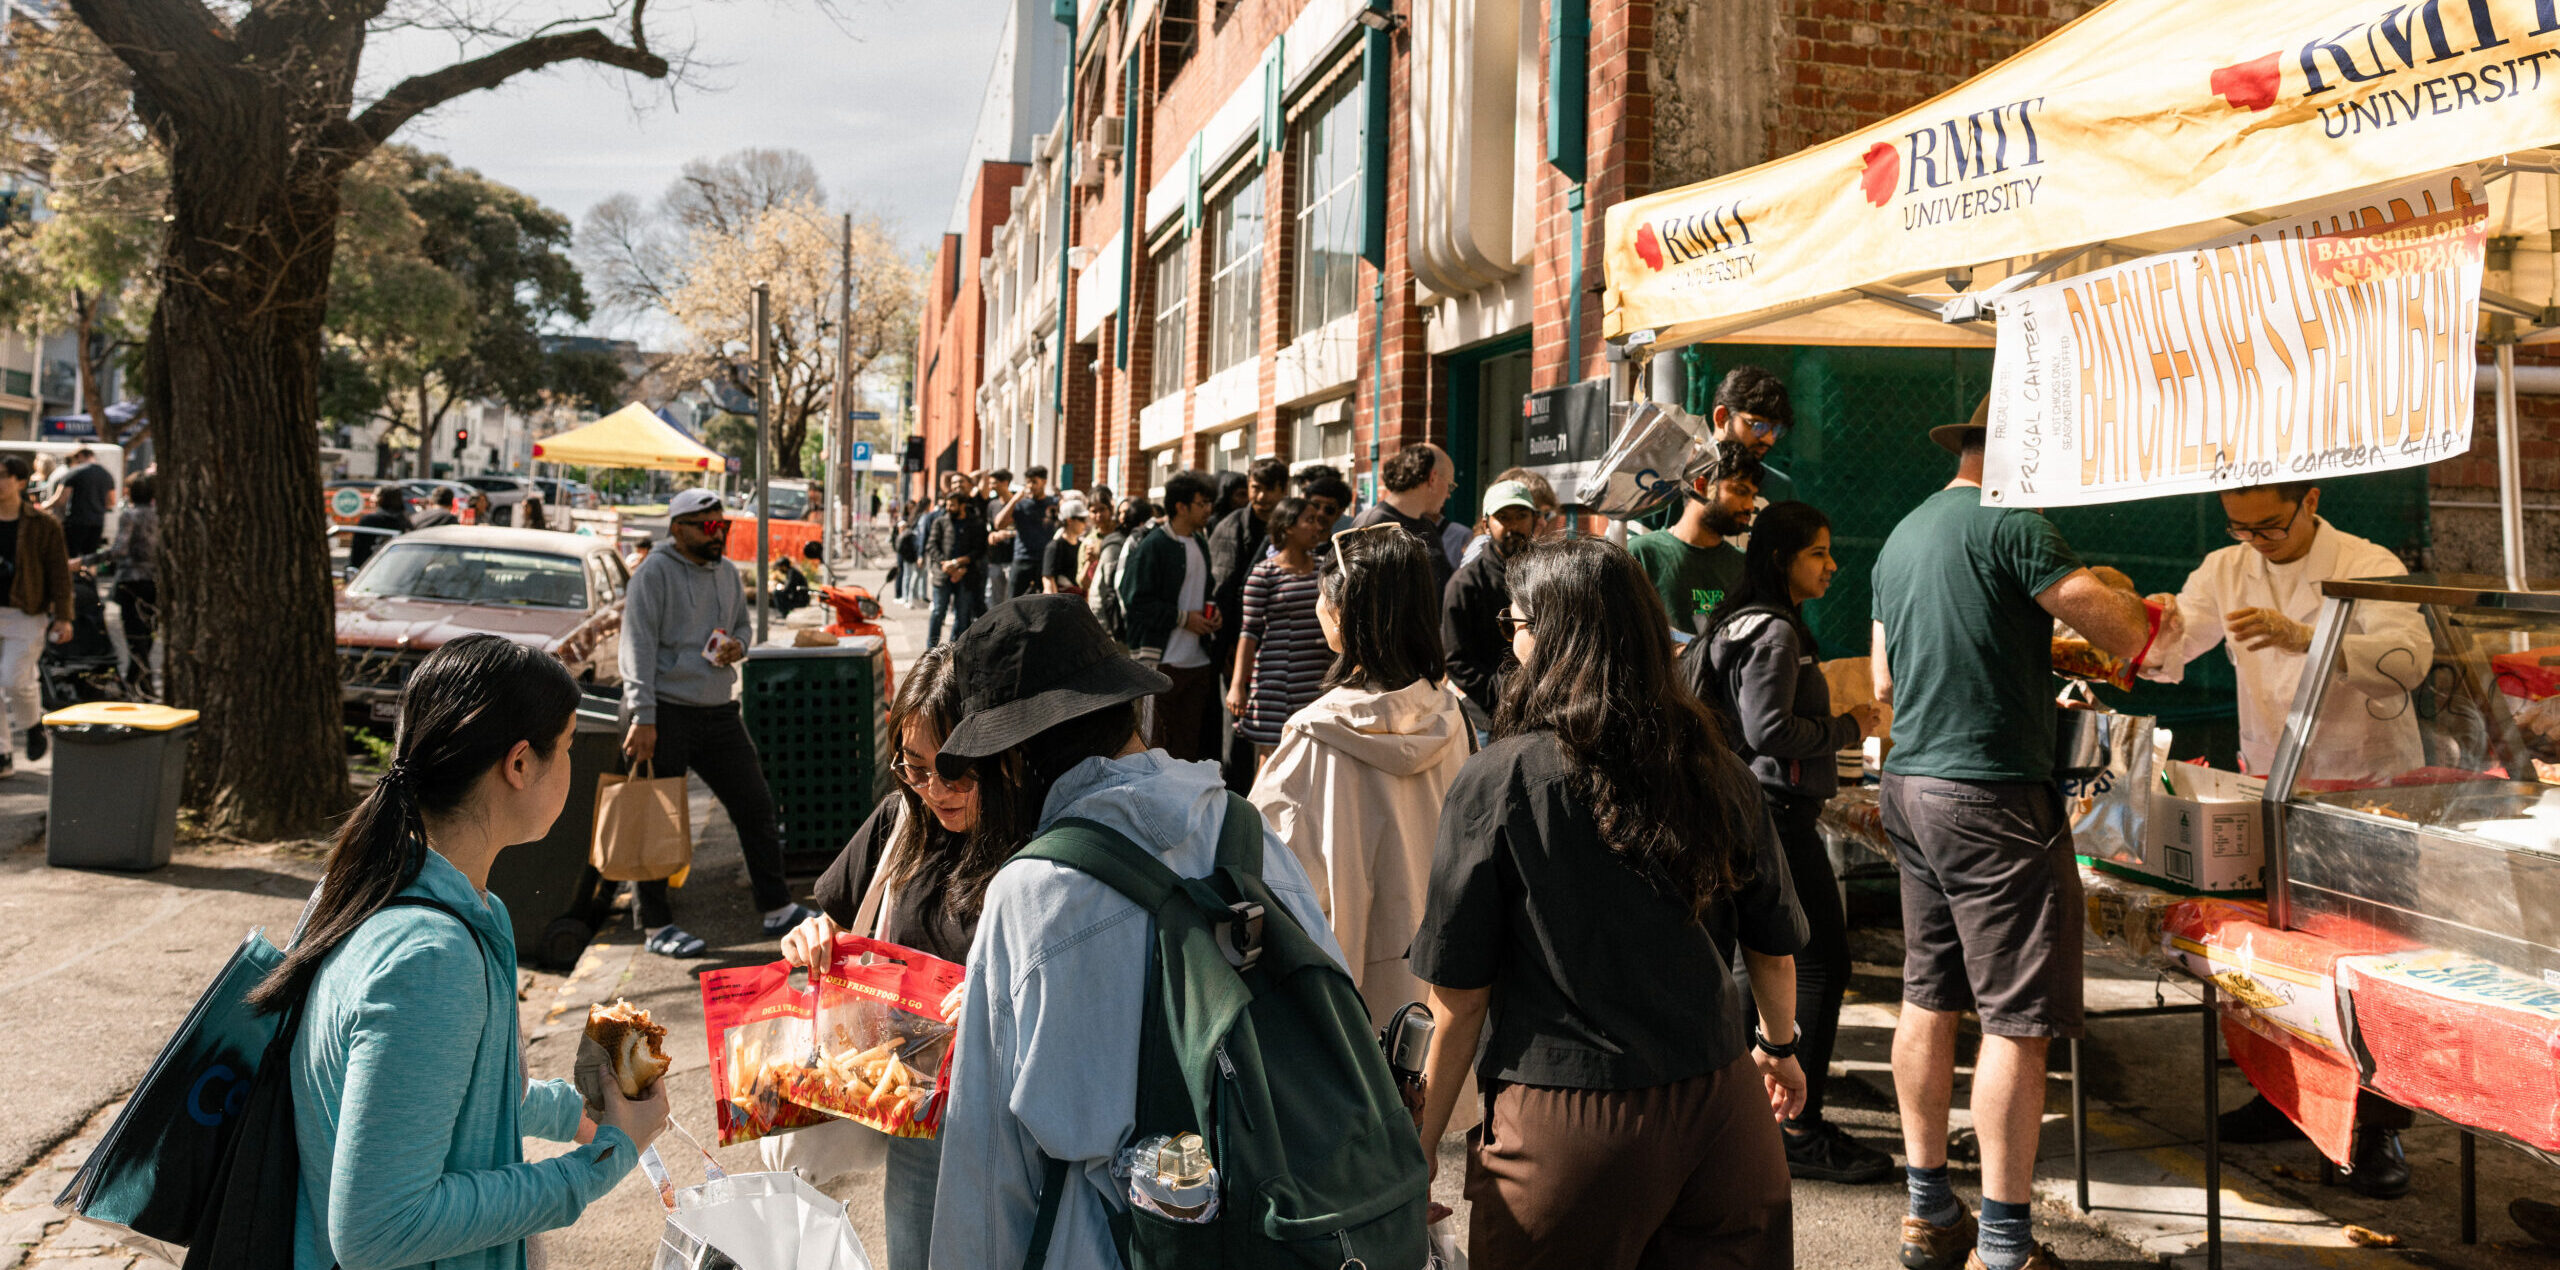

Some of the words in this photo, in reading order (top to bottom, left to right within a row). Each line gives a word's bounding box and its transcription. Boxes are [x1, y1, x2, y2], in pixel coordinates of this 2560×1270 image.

[2317, 49, 2560, 138] UNIVERSIT
[1905, 97, 2045, 195] RMIT
[1904, 176, 2042, 230] UNIVERSITY
[1663, 200, 1753, 264] RMIT
[2316, 214, 2486, 262] BATCHELOR'S
[2017, 300, 2041, 402] CANTEEN
[2061, 335, 2071, 378] STUFFED
[2063, 233, 2297, 487] BATCHELOR'S
[2052, 380, 2061, 414] CHICKS
[2062, 378, 2072, 399] AND
[1530, 435, 1557, 457] Building
[1557, 433, 1568, 452] 71
[2052, 415, 2061, 436] HOT
[2062, 400, 2073, 450] SEASONED
[856, 445, 866, 458] P
[2020, 411, 2042, 494] FRUGAL
[2210, 448, 2279, 486] frugal
[2292, 441, 2386, 473] canteen
[1692, 589, 1725, 602] INNER
[762, 1004, 782, 1016] DELI
[825, 975, 847, 989] DELI
[846, 981, 876, 996] FRESH
[876, 989, 900, 1002] FOOD
[900, 997, 907, 1005] 2
[908, 999, 923, 1010] GO
